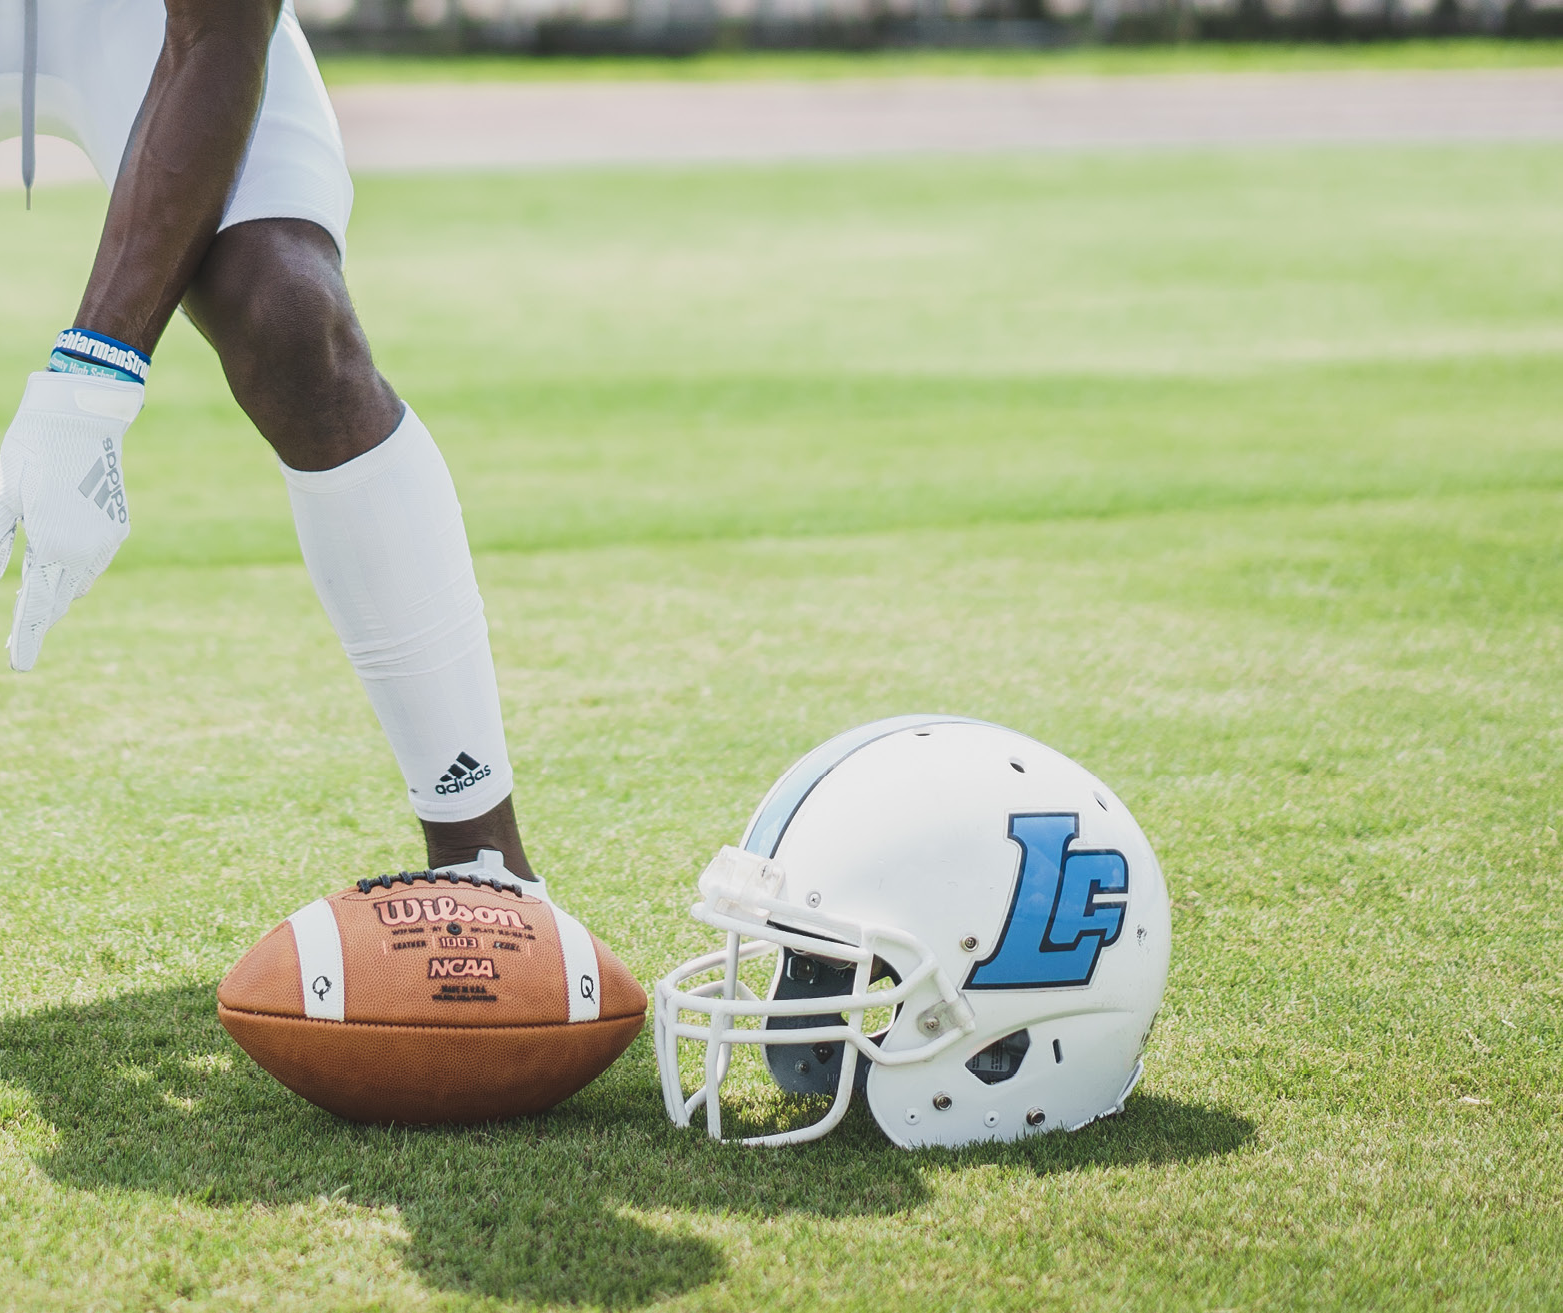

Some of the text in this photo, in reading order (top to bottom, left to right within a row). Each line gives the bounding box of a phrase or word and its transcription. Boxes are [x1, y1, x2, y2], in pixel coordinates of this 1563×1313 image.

[102, 437, 127, 524] adidas
[435, 764, 492, 796] adidas
[373, 896, 527, 930] Wilson
[961, 812, 1130, 990] LC
[393, 937, 479, 950] LEATHER 1003
[428, 958, 496, 979] NCAA
[312, 975, 333, 1002] Q
[580, 974, 596, 1005] Q
